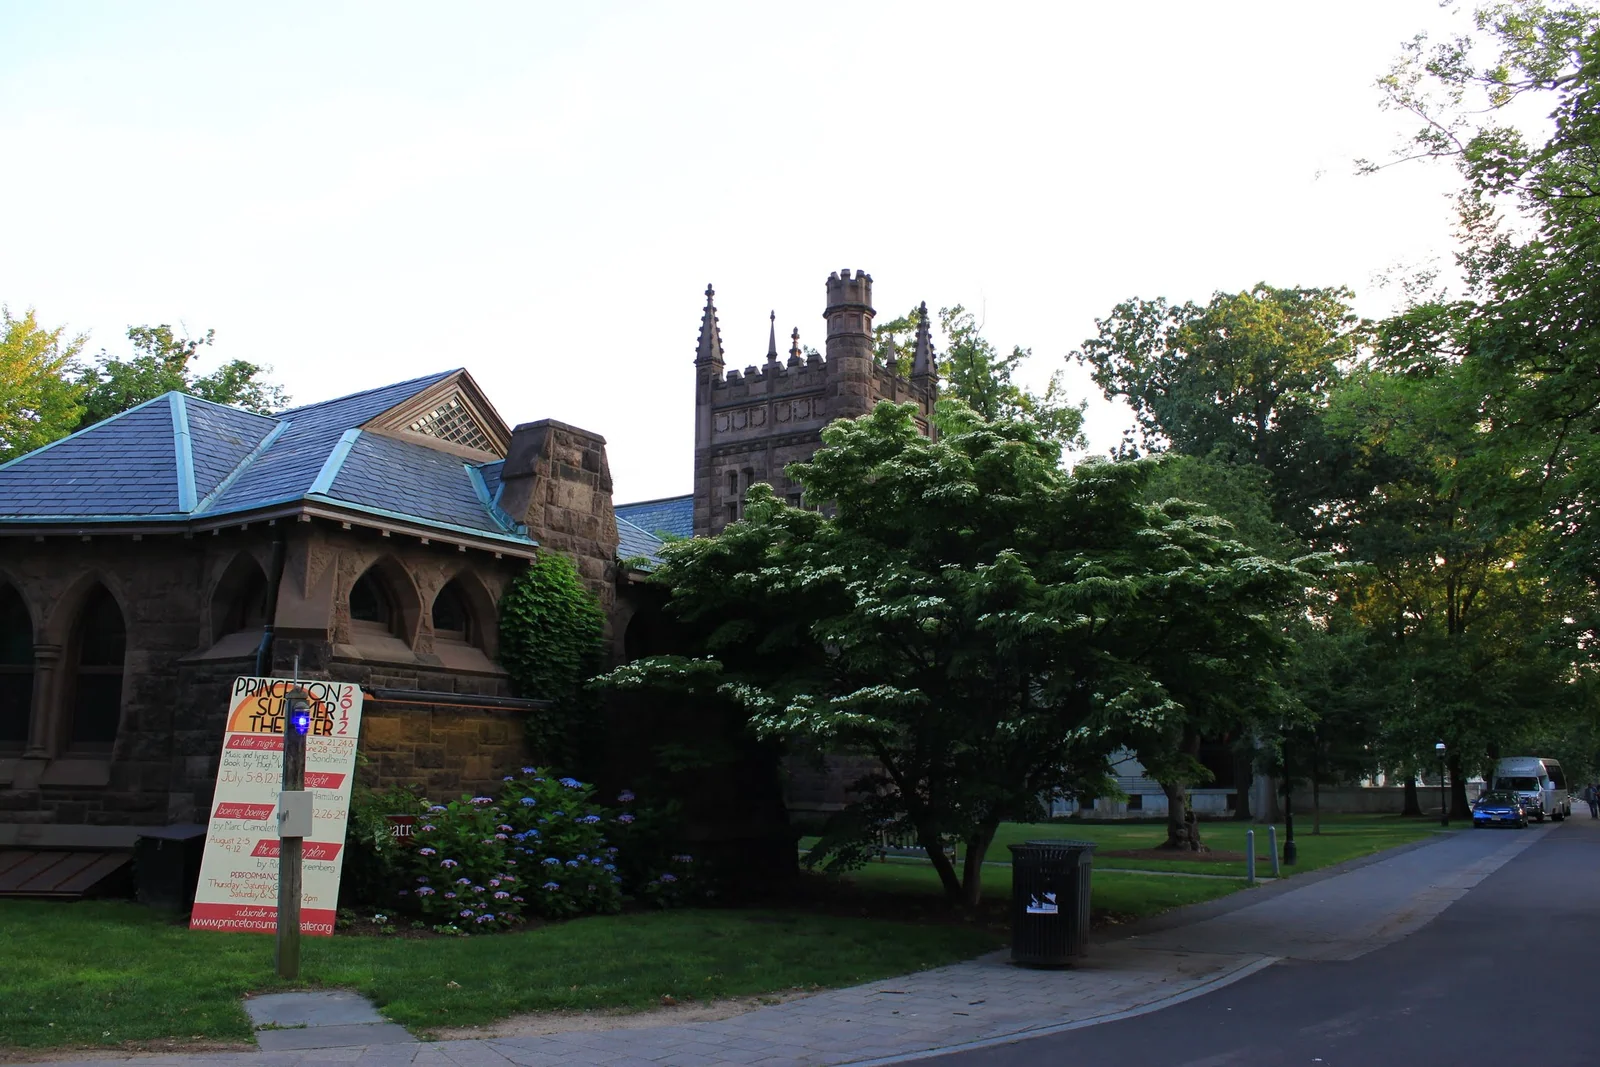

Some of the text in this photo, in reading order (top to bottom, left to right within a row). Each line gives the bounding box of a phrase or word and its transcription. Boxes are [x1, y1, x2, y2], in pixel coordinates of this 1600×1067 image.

[337, 685, 354, 735] 2012
[249, 715, 334, 736] THEER
[257, 739, 276, 750] night
[308, 738, 324, 746] June
[272, 751, 281, 763] by
[223, 758, 241, 767] Book
[243, 759, 253, 770] by
[221, 770, 243, 787] July
[218, 804, 269, 820] boeing boeing
[213, 821, 224, 832] by
[225, 821, 241, 831] Marc
[208, 835, 235, 847] August
[257, 842, 269, 855] the
[304, 845, 326, 860] plan
[256, 858, 267, 871] by
[302, 861, 336, 874] reenberg
[229, 889, 260, 901] Saturday
[303, 893, 319, 904] 2pm
[235, 907, 267, 918] subscribe
